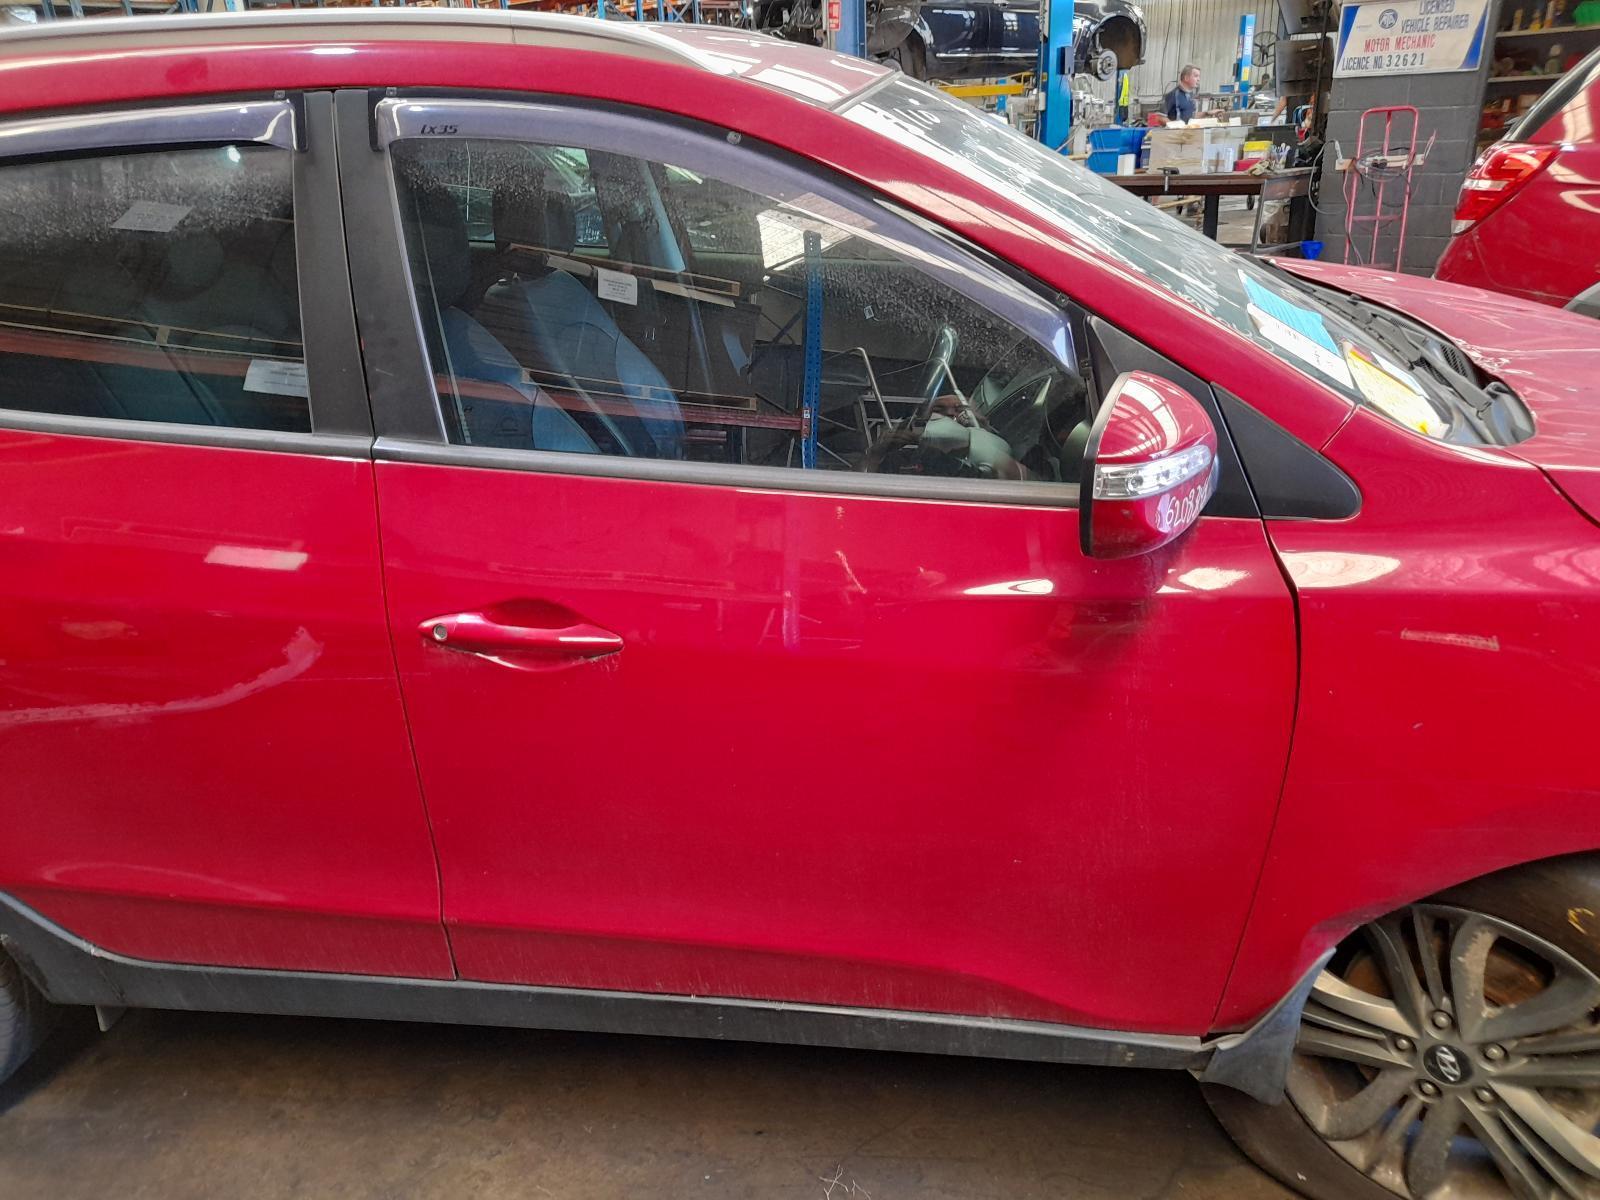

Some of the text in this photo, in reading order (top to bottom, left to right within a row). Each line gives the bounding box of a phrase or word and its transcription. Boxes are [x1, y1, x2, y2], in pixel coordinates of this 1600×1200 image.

[1419, 0, 1455, 15] LICENSED
[1401, 18, 1430, 33] VEHICLE
[1433, 14, 1469, 31] REPAIRER
[1364, 34, 1436, 53] MOTOR MECHANIC
[1341, 56, 1370, 71] LICENCE
[1386, 53, 1425, 67] 32621
